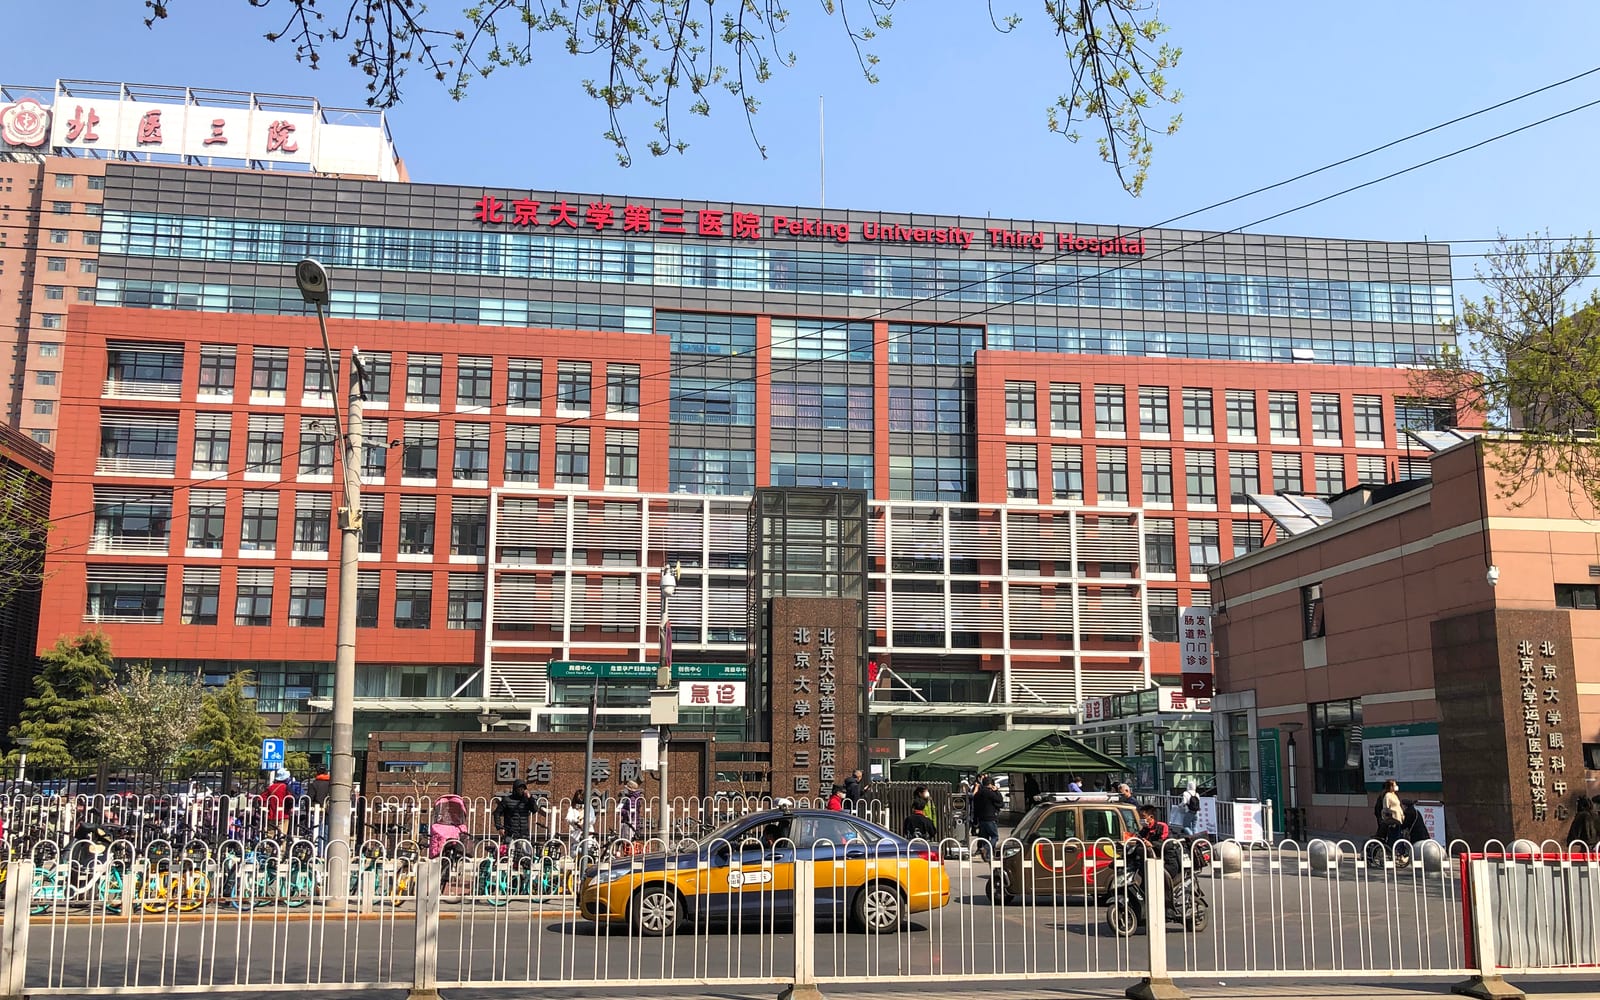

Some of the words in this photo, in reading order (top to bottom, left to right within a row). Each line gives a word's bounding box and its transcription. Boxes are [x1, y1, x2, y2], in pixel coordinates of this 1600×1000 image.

[66, 104, 299, 152] 北医三院
[475, 195, 761, 240] 北京大学第三医院
[773, 216, 849, 242] Peking
[862, 221, 975, 250] University
[987, 227, 1045, 249] Third
[1058, 232, 1147, 257] Hospital
[1184, 615, 1197, 666] 肠道门诊
[1196, 615, 1208, 666] 发热门诊
[690, 683, 736, 704] 急诊
[818, 627, 836, 809] 北京大学第三临床医学
[1519, 639, 1549, 822] 北京大学运动医学研究所
[1541, 640, 1570, 820] 北京大学眼科中心
[265, 741, 276, 760] P
[497, 758, 552, 783] 团结
